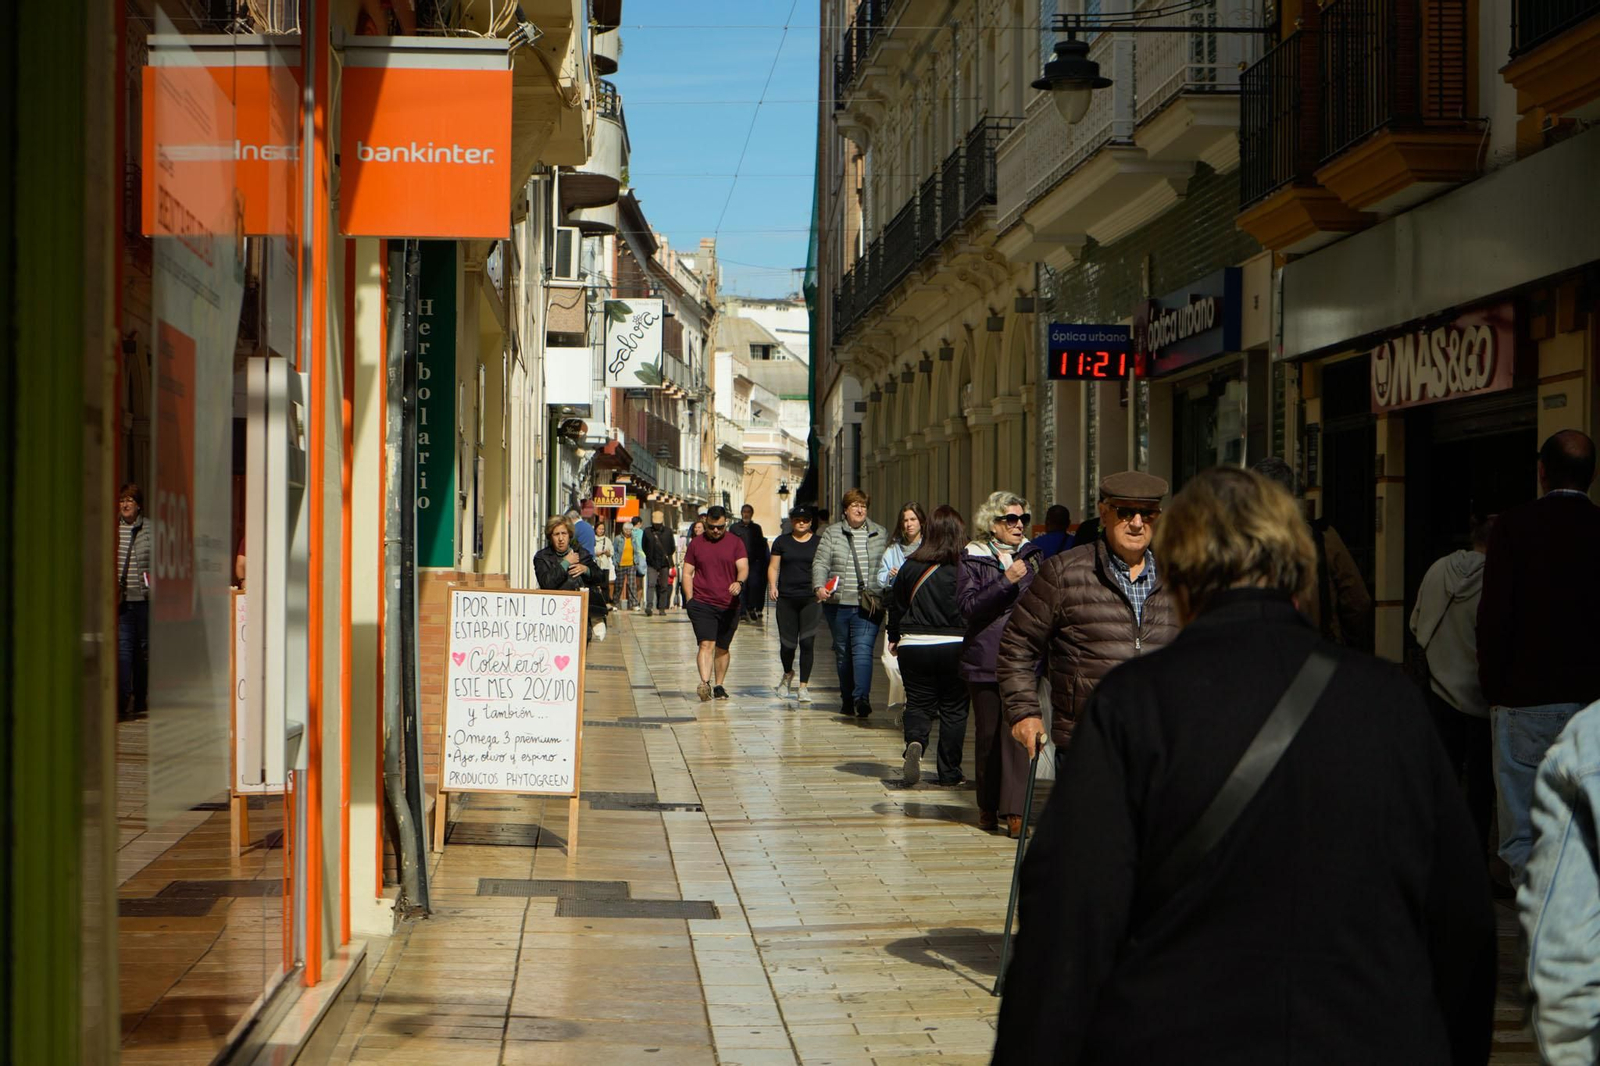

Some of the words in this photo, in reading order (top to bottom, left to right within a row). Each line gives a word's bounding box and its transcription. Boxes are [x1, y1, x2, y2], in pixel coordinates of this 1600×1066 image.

[357, 140, 495, 164] bankinter.
[1052, 330, 1087, 343] óptica
[1088, 331, 1128, 343] urbano
[1147, 307, 1177, 360] óptica
[1178, 293, 1215, 340] urbano
[1061, 351, 1126, 377] 11:21
[1391, 325, 1493, 406] MAS&GO
[415, 299, 434, 508] Herbolario
[594, 497, 623, 505] TABACOS
[541, 597, 557, 616] LO
[516, 621, 574, 644] ESPERANDO
[470, 648, 548, 674] Colesterol
[455, 677, 481, 697] ESTE
[488, 678, 513, 699] MES
[467, 707, 477, 727] y
[503, 730, 511, 744] 3
[480, 751, 507, 763] olivo
[510, 754, 516, 765] y
[449, 771, 499, 786] PRODUCTOS
[506, 772, 569, 787] PHYTOGREEN
